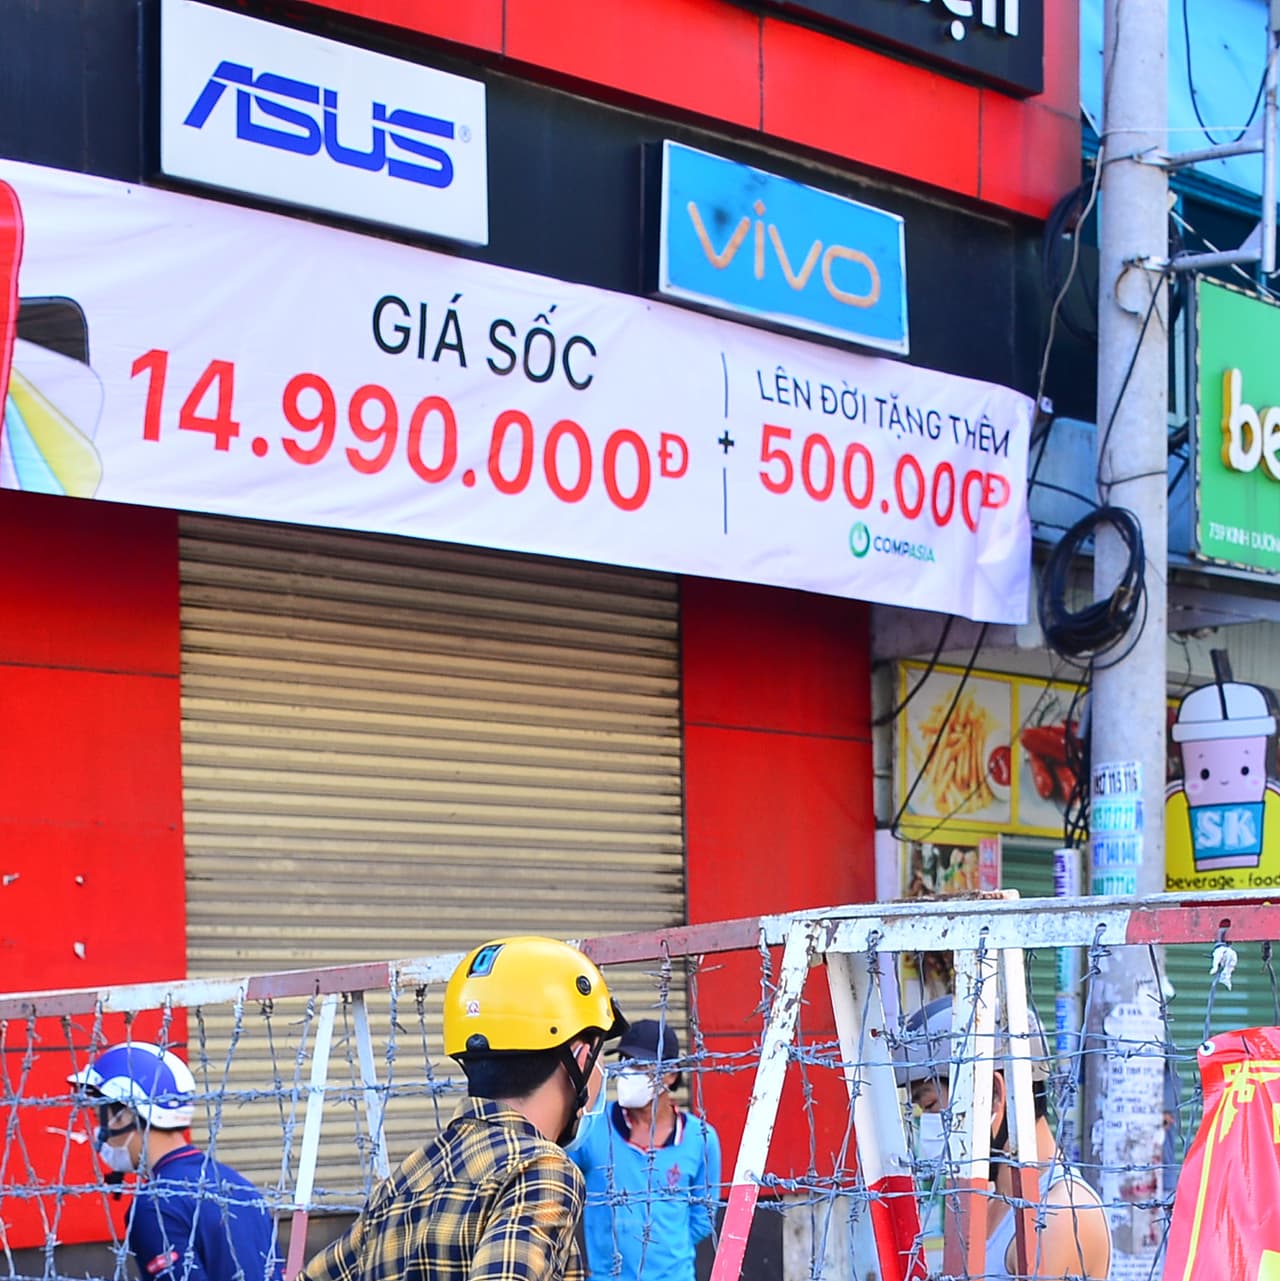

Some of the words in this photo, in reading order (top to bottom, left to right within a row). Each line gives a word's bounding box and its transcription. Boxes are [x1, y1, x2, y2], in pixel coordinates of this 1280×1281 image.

[183, 60, 455, 190] ASUS
[372, 293, 468, 369] GIÁ
[487, 304, 598, 390] SỐC
[130, 349, 689, 511] 14.990.000Đ
[757, 365, 811, 411] LÊN
[819, 380, 867, 424] ĐỜI
[875, 393, 941, 440] TẶNG
[873, 536, 935, 563] COMPASIA
[1195, 808, 1257, 850] SK
[1166, 873, 1235, 890] beverage
